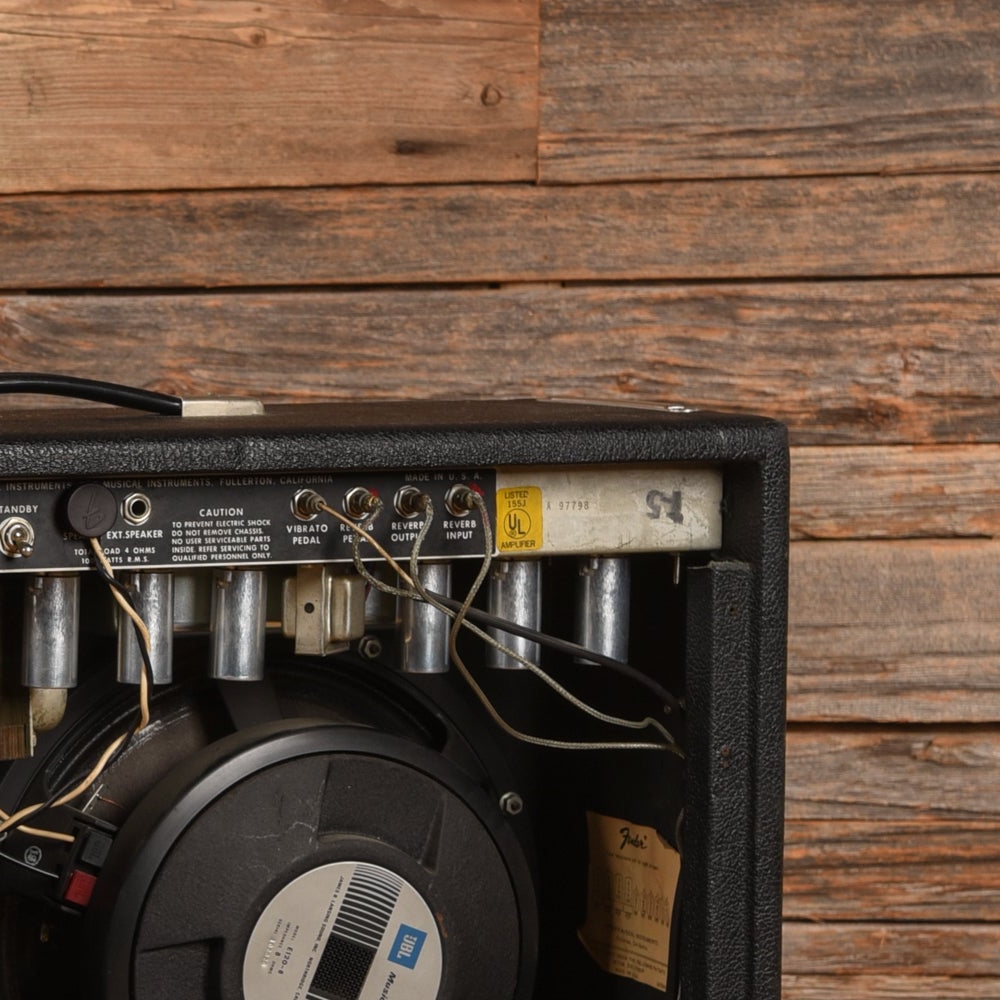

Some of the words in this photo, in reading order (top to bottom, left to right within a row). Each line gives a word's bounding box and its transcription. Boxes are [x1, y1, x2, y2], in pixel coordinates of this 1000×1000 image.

[280, 475, 333, 485] CALIFORNIA
[405, 473, 430, 481] MADE
[504, 491, 529, 499] LISTED
[559, 501, 589, 510] 97798
[199, 508, 244, 517] CAUTION
[286, 524, 328, 533] VIBRATO
[443, 520, 476, 529] REVERB
[446, 531, 473, 540] INPUT
[292, 536, 321, 545] PEDAL
[501, 540, 536, 549] AMPLIFIER
[323, 900, 334, 922] LANSING
[396, 934, 418, 958] JBL
[278, 947, 293, 974] E120-8
